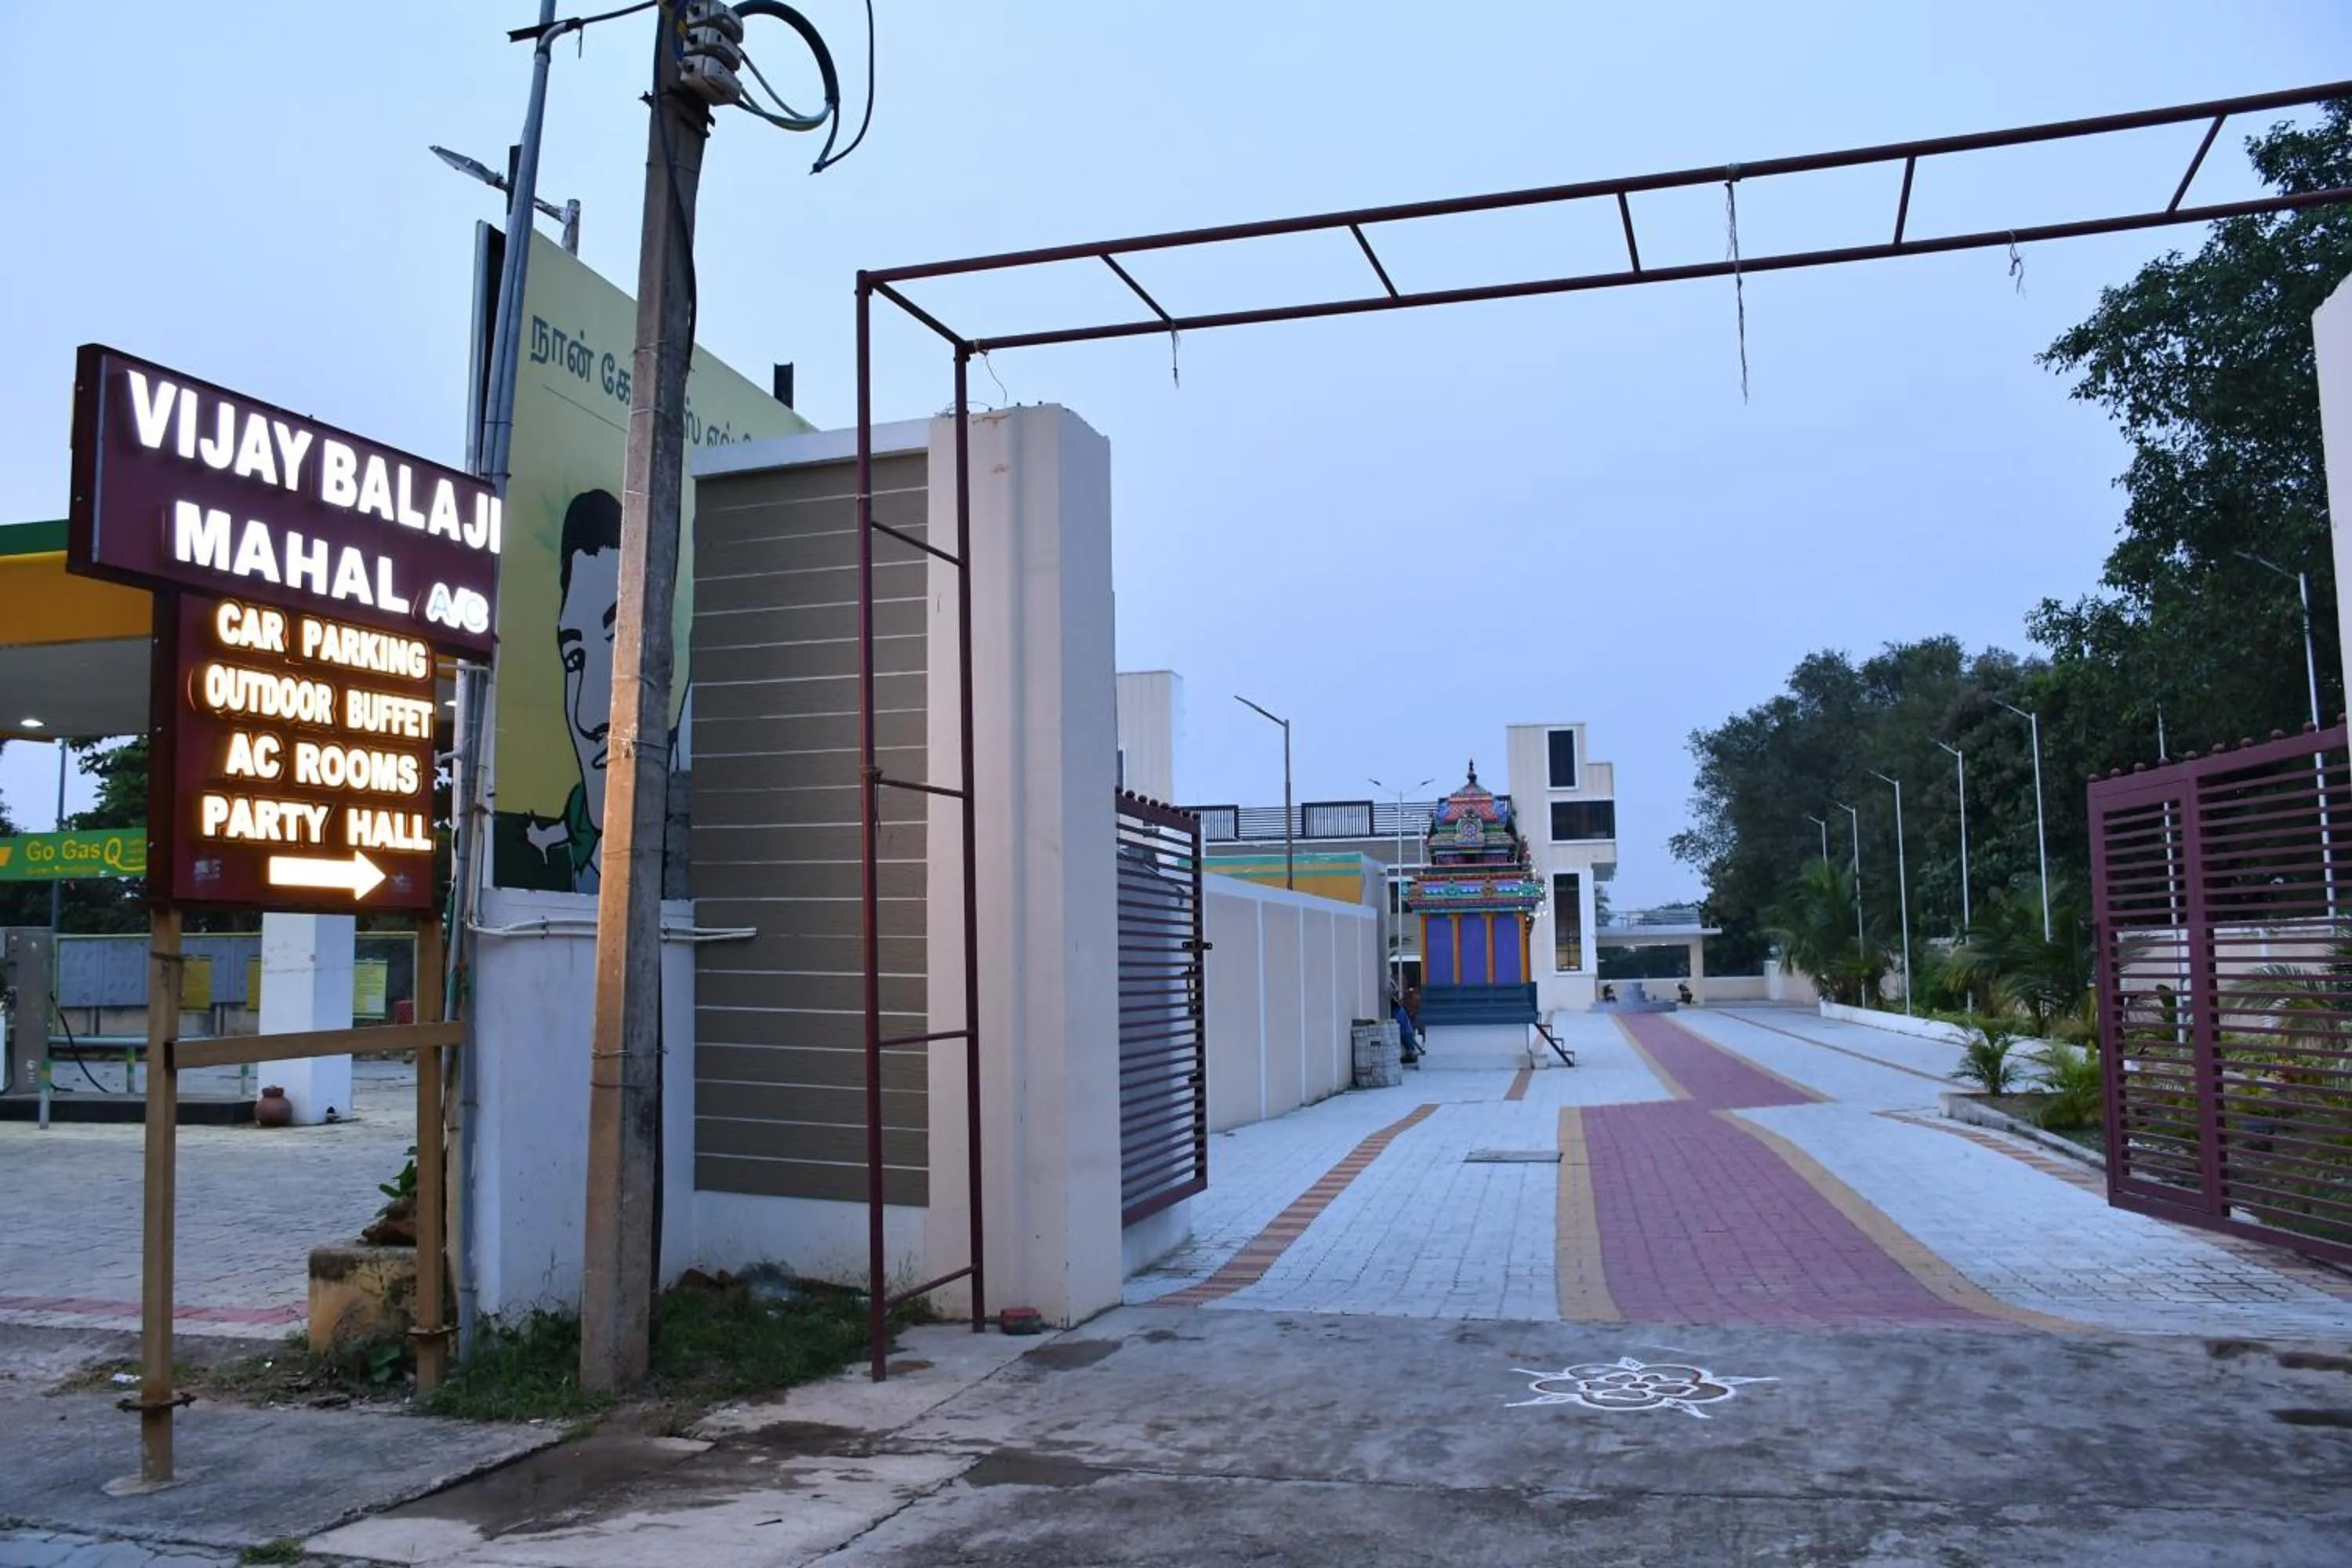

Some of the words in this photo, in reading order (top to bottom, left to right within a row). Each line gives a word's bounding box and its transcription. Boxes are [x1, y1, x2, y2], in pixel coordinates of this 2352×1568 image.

[530, 315, 594, 382] நான்
[128, 370, 314, 492] VIJAY
[321, 439, 502, 554] BALAJI
[175, 500, 410, 614] MAHAL
[216, 603, 285, 653] CAR
[303, 619, 429, 679] PARKING
[205, 664, 335, 726] OUTDOOR
[347, 689, 434, 739] BUFFET
[225, 731, 281, 779] AC
[296, 742, 419, 795] ROOMS
[26, 841, 55, 861] Go
[62, 839, 101, 860] Gas
[201, 794, 329, 844] PARTY
[346, 808, 434, 851] HALL
